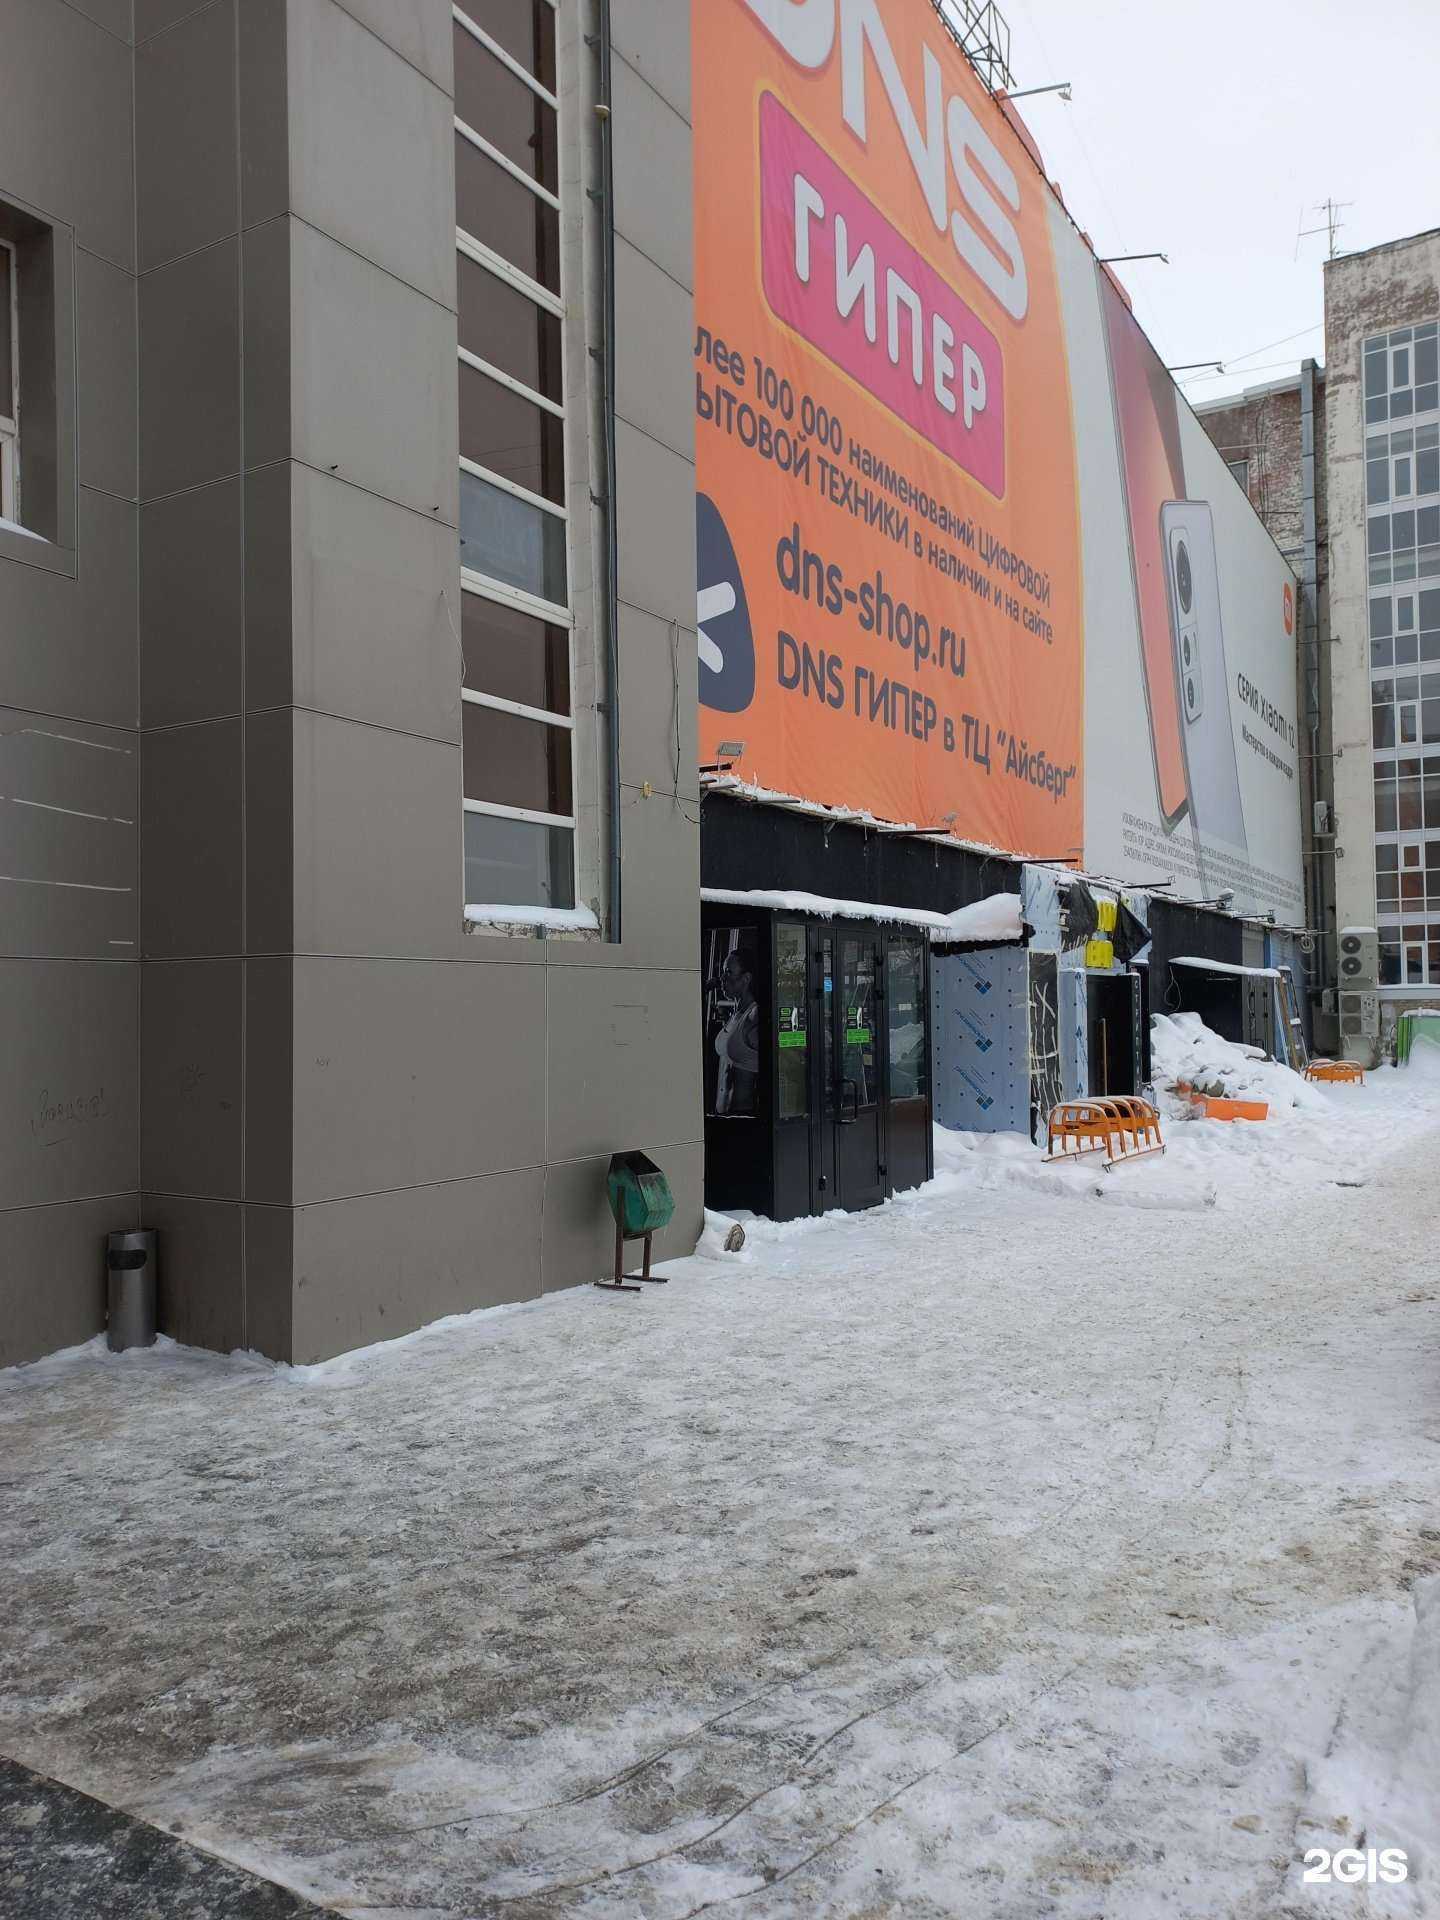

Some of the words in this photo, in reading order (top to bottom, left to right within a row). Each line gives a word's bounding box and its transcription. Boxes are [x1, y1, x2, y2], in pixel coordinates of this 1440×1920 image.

[746, 0, 1028, 320] NS
[794, 173, 987, 430] ГИПЕР
[754, 356, 794, 421] 100
[801, 396, 842, 455] 000
[849, 438, 975, 550] наименований
[979, 528, 1050, 608] ЦИФРОВОЙ
[817, 456, 908, 548] ТЕХНИКИ
[914, 531, 923, 557] в
[928, 544, 990, 602] наличии
[994, 586, 1002, 609] и
[1006, 593, 1019, 623] на
[1022, 607, 1053, 645] сайте
[777, 522, 966, 677] dns-shop.ru
[778, 630, 844, 709] DNS
[854, 666, 936, 743] ГИПЕР
[944, 717, 955, 753] в
[962, 714, 990, 775] ТЦ
